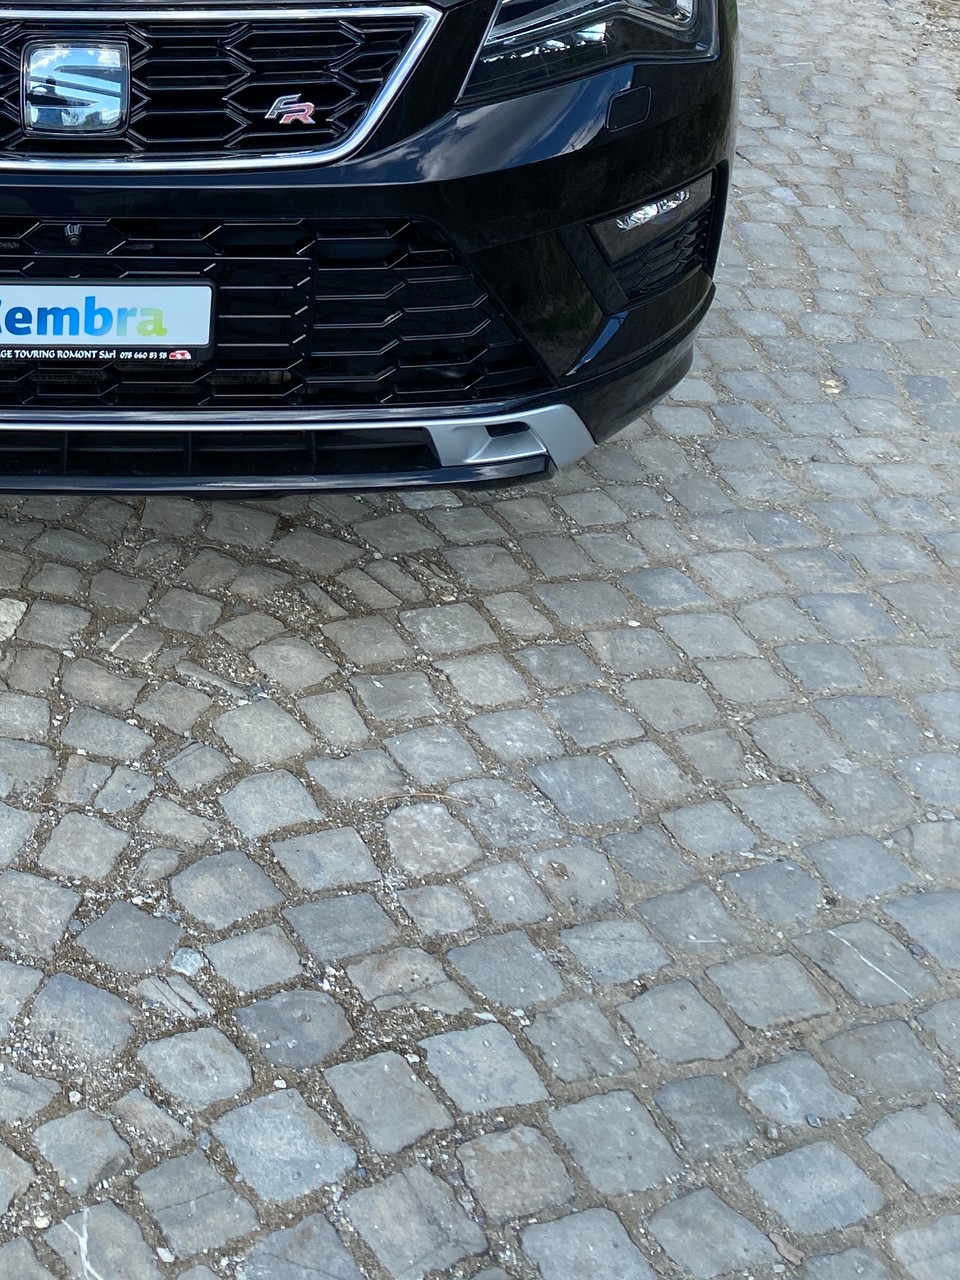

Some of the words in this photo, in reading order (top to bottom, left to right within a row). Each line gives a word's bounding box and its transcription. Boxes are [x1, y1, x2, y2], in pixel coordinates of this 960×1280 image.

[265, 93, 316, 124] FR
[14, 349, 55, 359] TOURING
[57, 349, 97, 359] ROMONT
[119, 351, 133, 360] 078
[134, 351, 148, 360] 660
